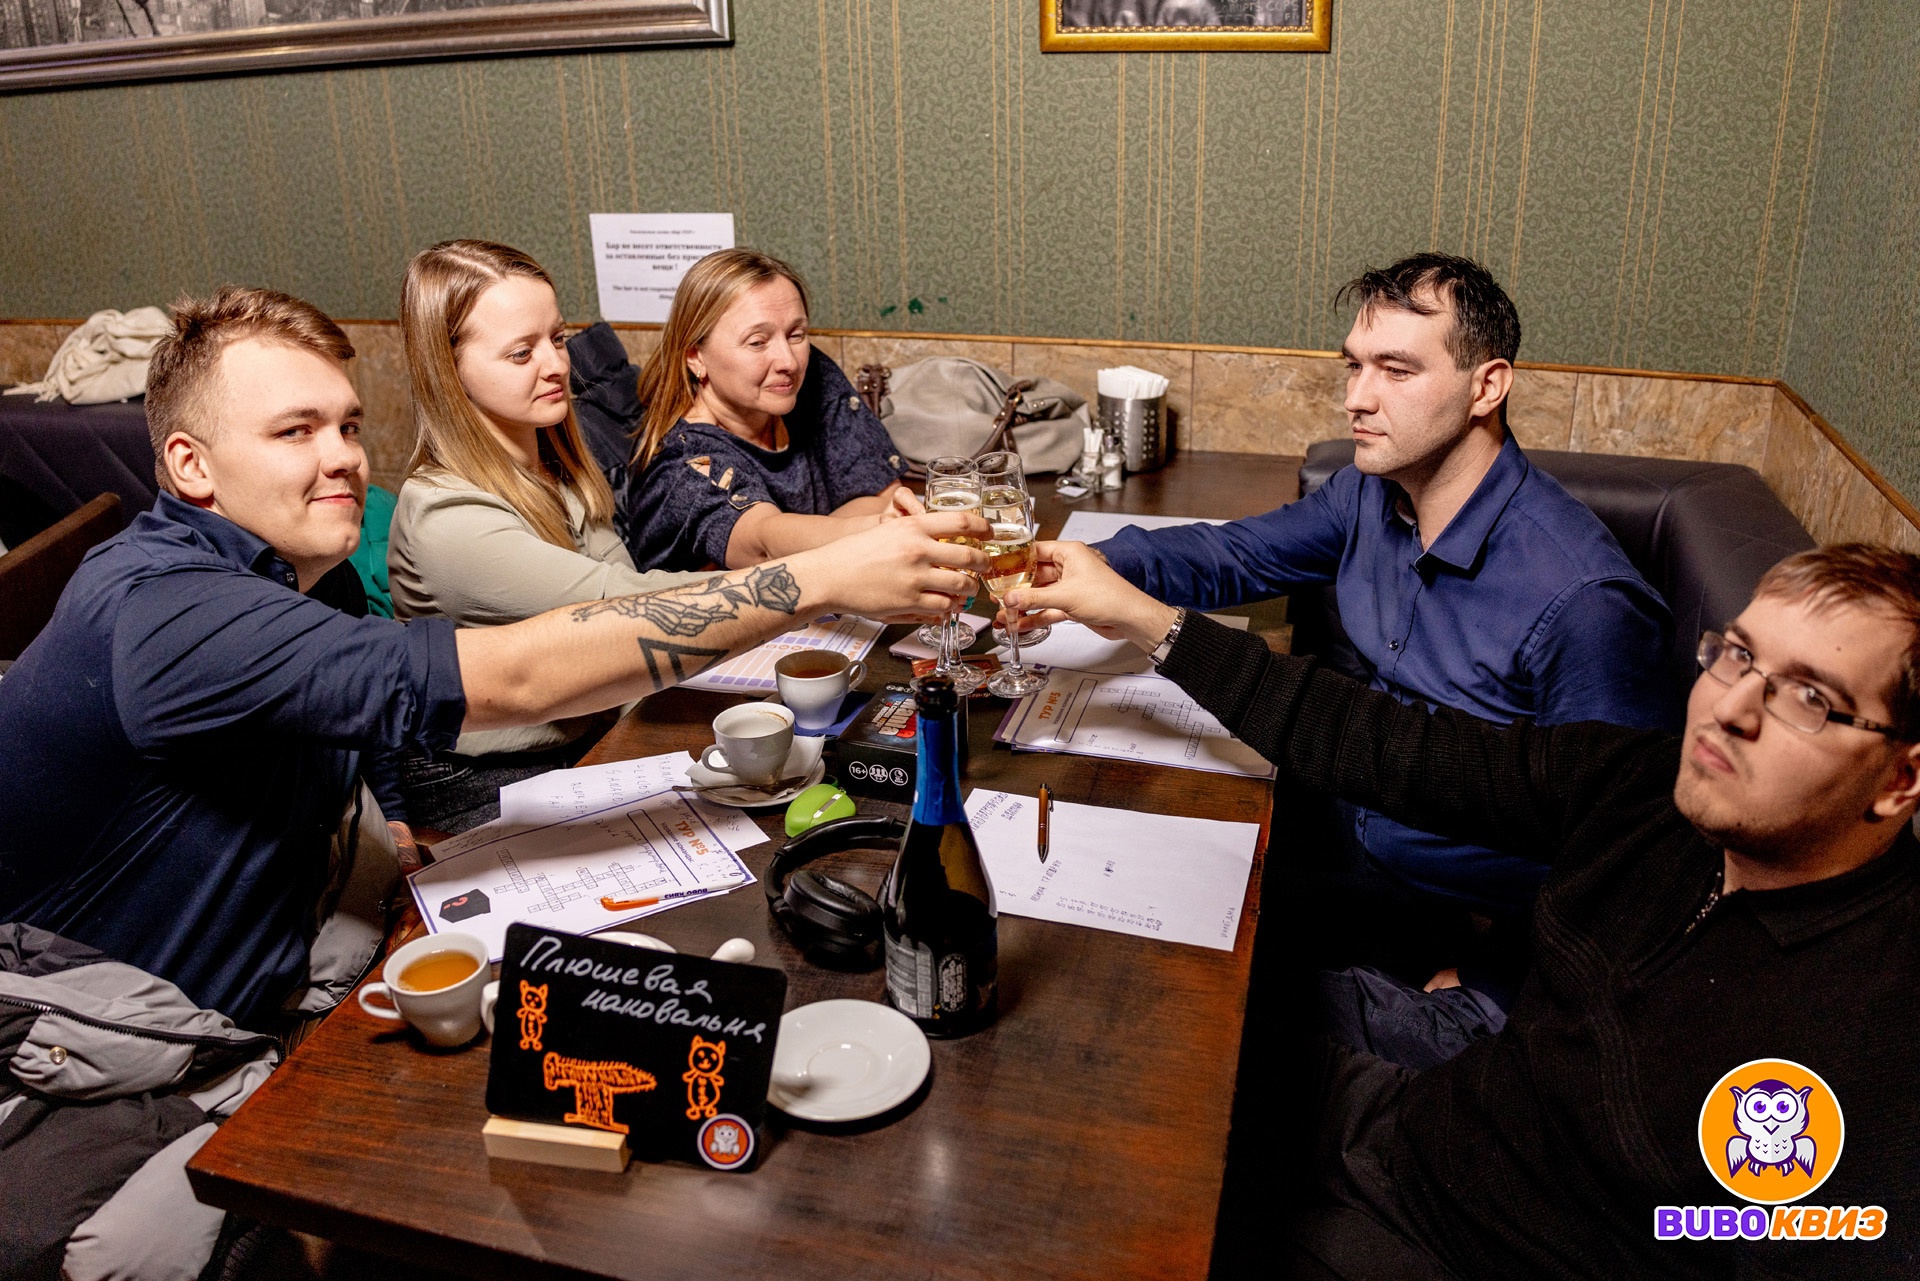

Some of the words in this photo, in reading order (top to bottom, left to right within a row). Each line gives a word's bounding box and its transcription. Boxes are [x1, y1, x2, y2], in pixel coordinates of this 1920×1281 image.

[605, 242, 620, 250] Бар
[615, 253, 665, 261] оставленные
[667, 252, 681, 260] без
[1038, 705, 1054, 719] ТУР
[1047, 691, 1061, 705] №5
[851, 766, 867, 775] 16+
[675, 820, 696, 838] ТУР
[688, 838, 709, 856] №5
[664, 891, 687, 899] КВИЗ
[687, 888, 708, 897] BUBO
[519, 936, 713, 1005] Плюшевая
[581, 989, 767, 1043] наковальня
